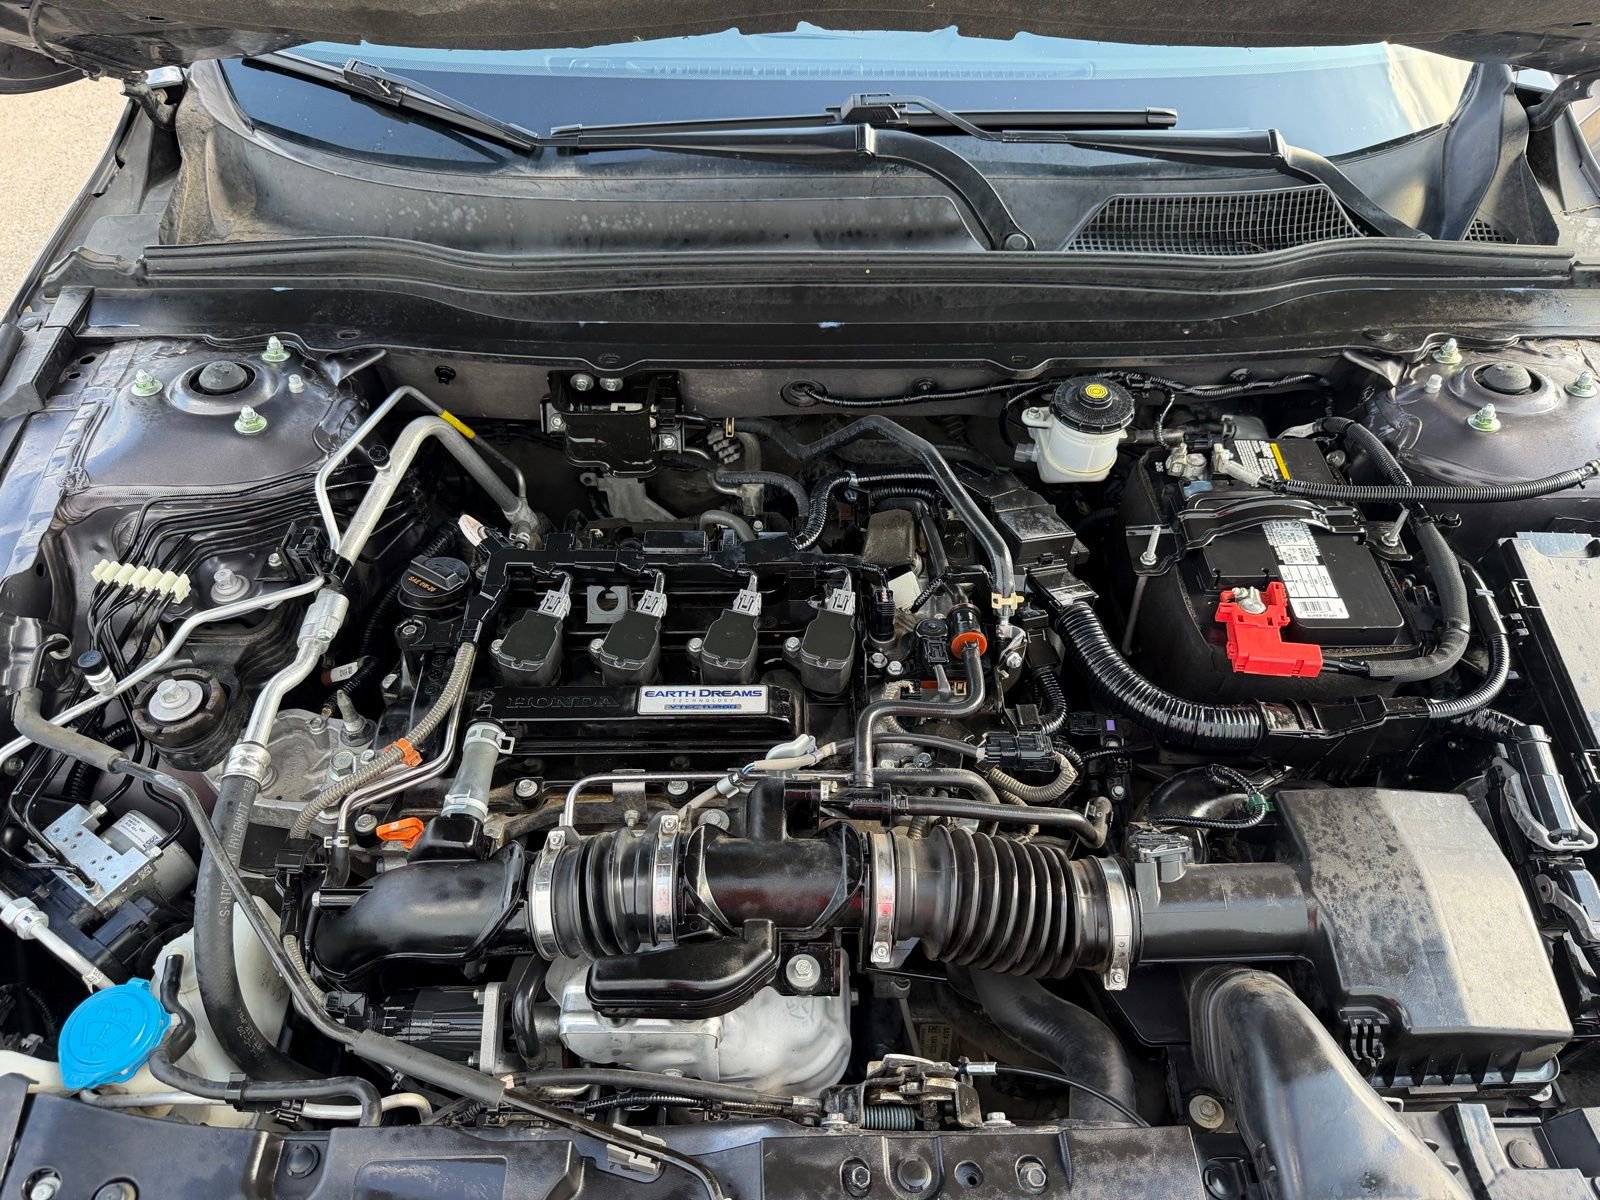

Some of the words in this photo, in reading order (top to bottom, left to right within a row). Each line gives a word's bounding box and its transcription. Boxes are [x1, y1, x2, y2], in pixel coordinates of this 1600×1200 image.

[644, 690, 696, 698] EARTH
[699, 689, 763, 698] DREAMS
[506, 696, 620, 709] HONDA
